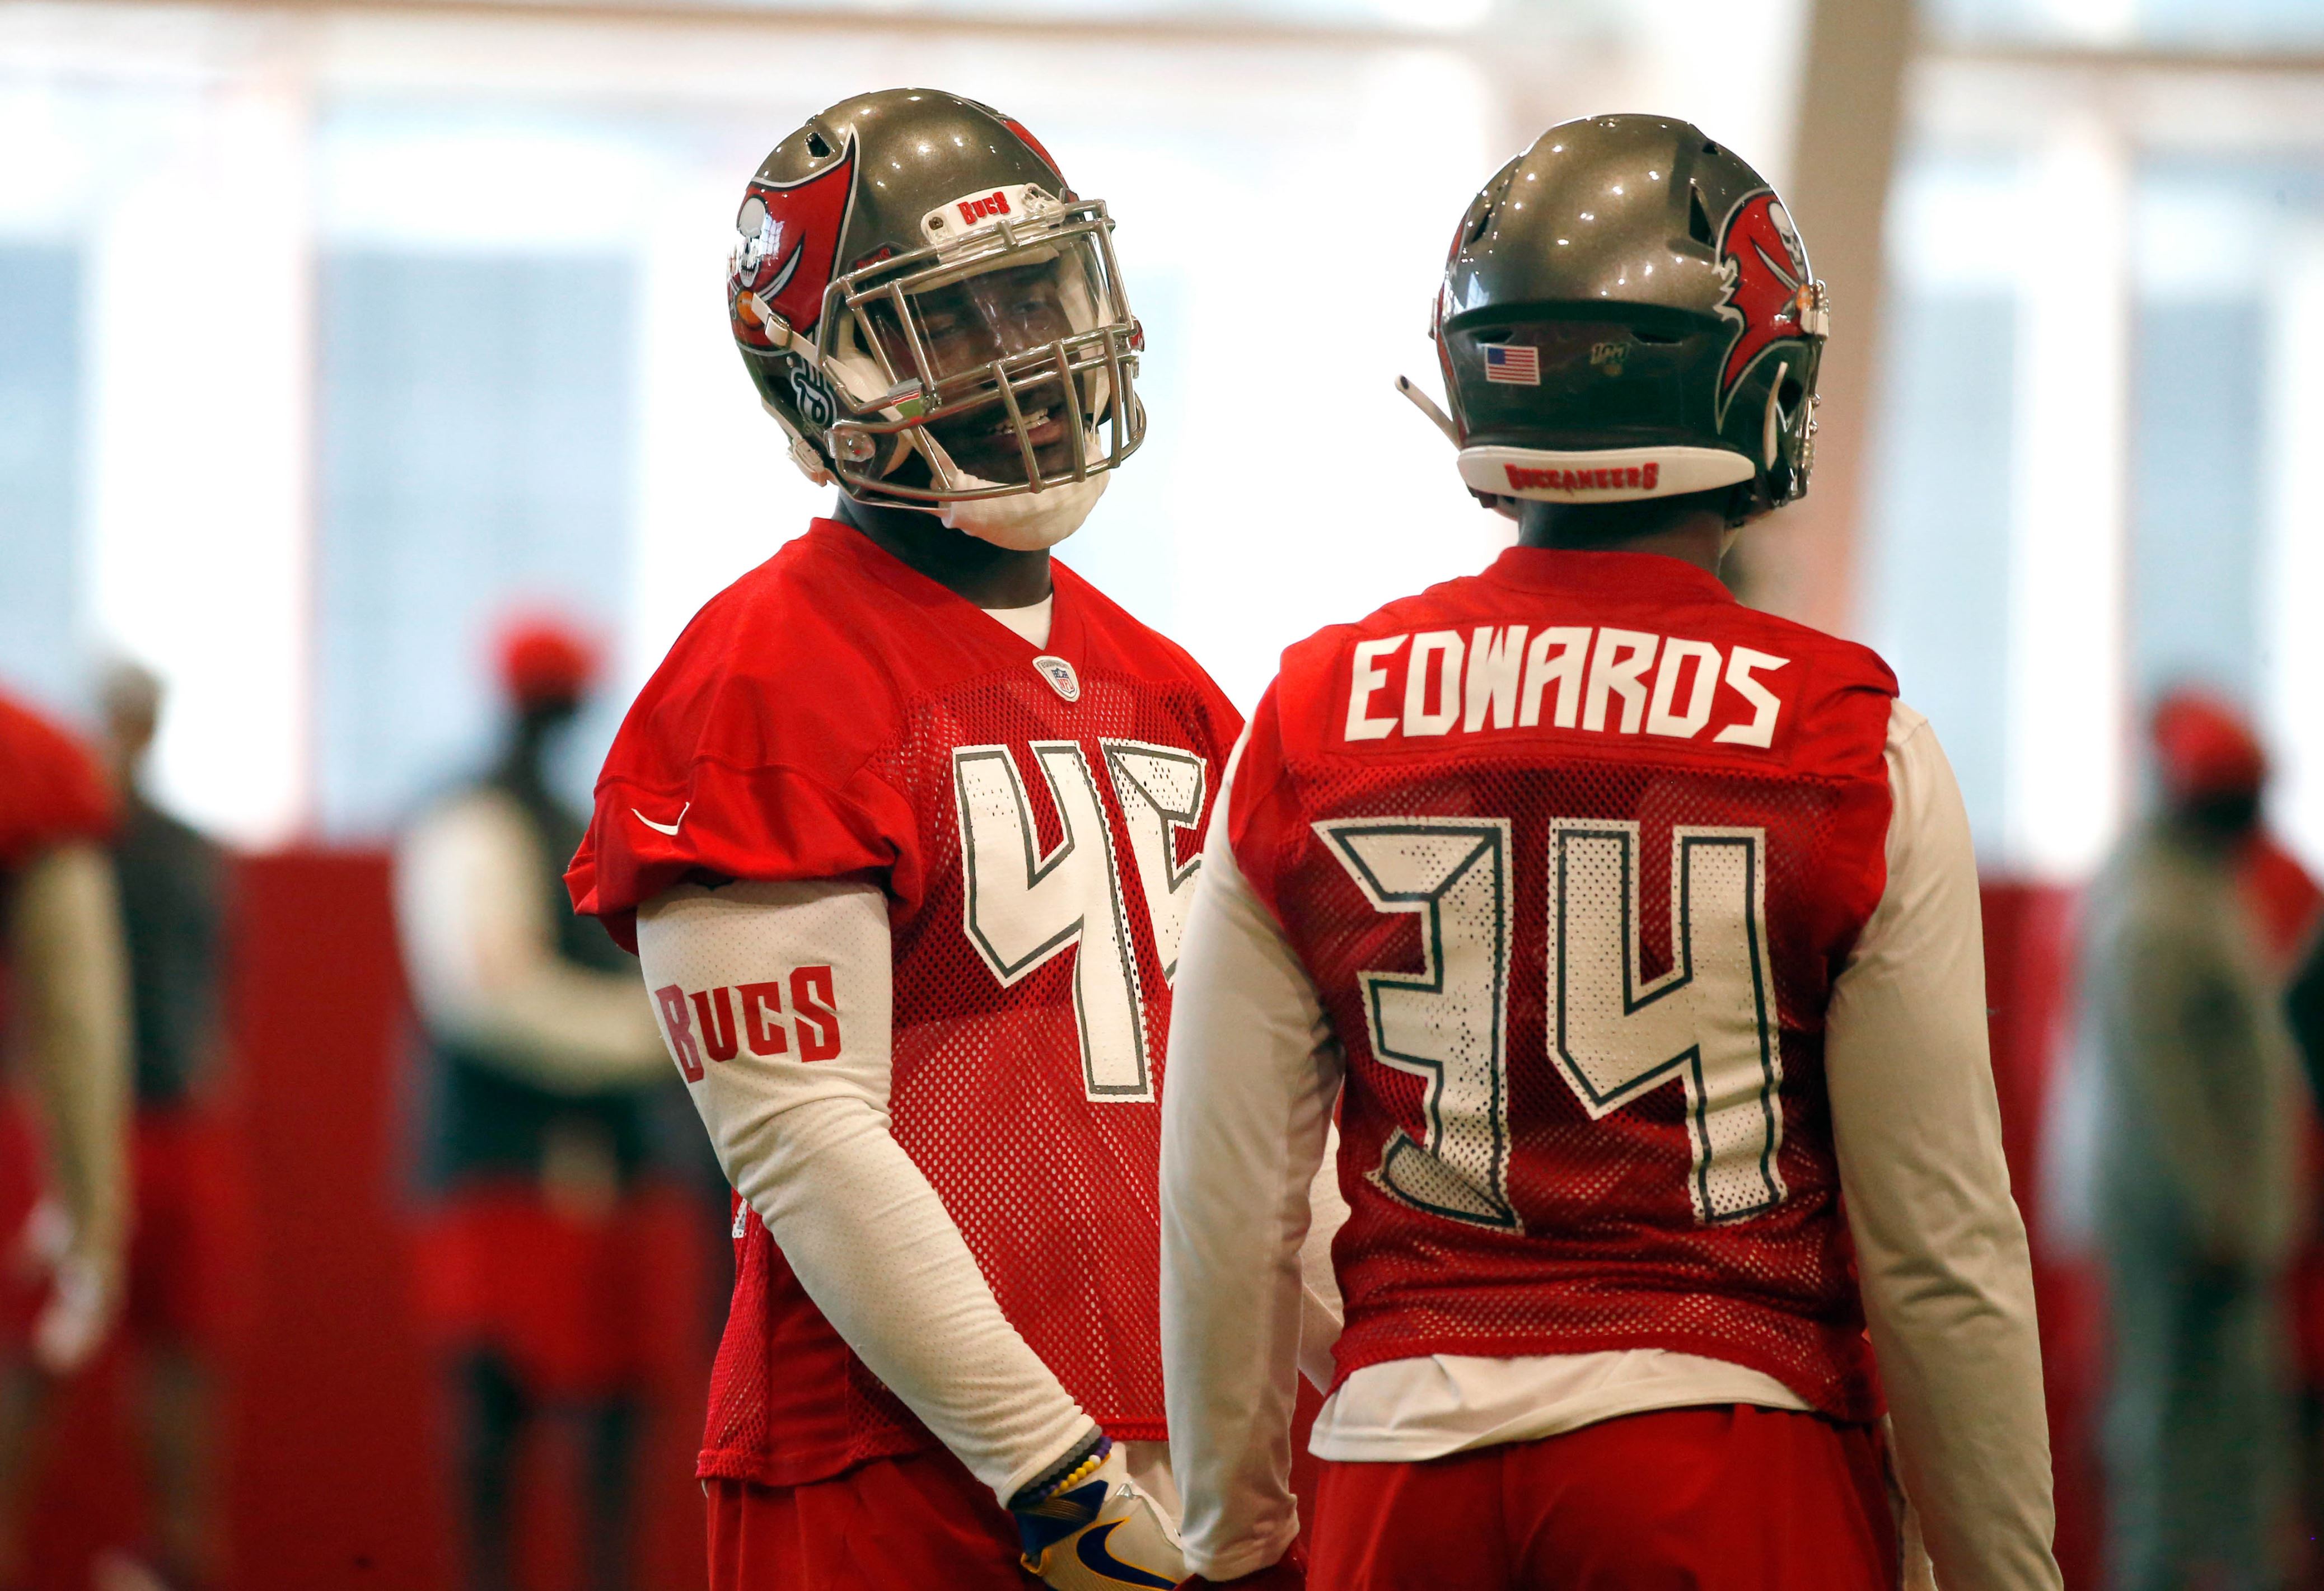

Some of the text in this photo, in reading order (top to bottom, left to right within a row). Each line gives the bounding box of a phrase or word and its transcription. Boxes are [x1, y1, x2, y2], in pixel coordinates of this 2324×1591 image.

[958, 191, 1010, 224] BUCS
[1504, 462, 1659, 495] BUCCANEERS
[1057, 678, 1074, 691] NFL
[1345, 625, 1790, 748] EDWARDS
[654, 965, 841, 1083] BUCS
[1311, 817, 1788, 1234] 34
